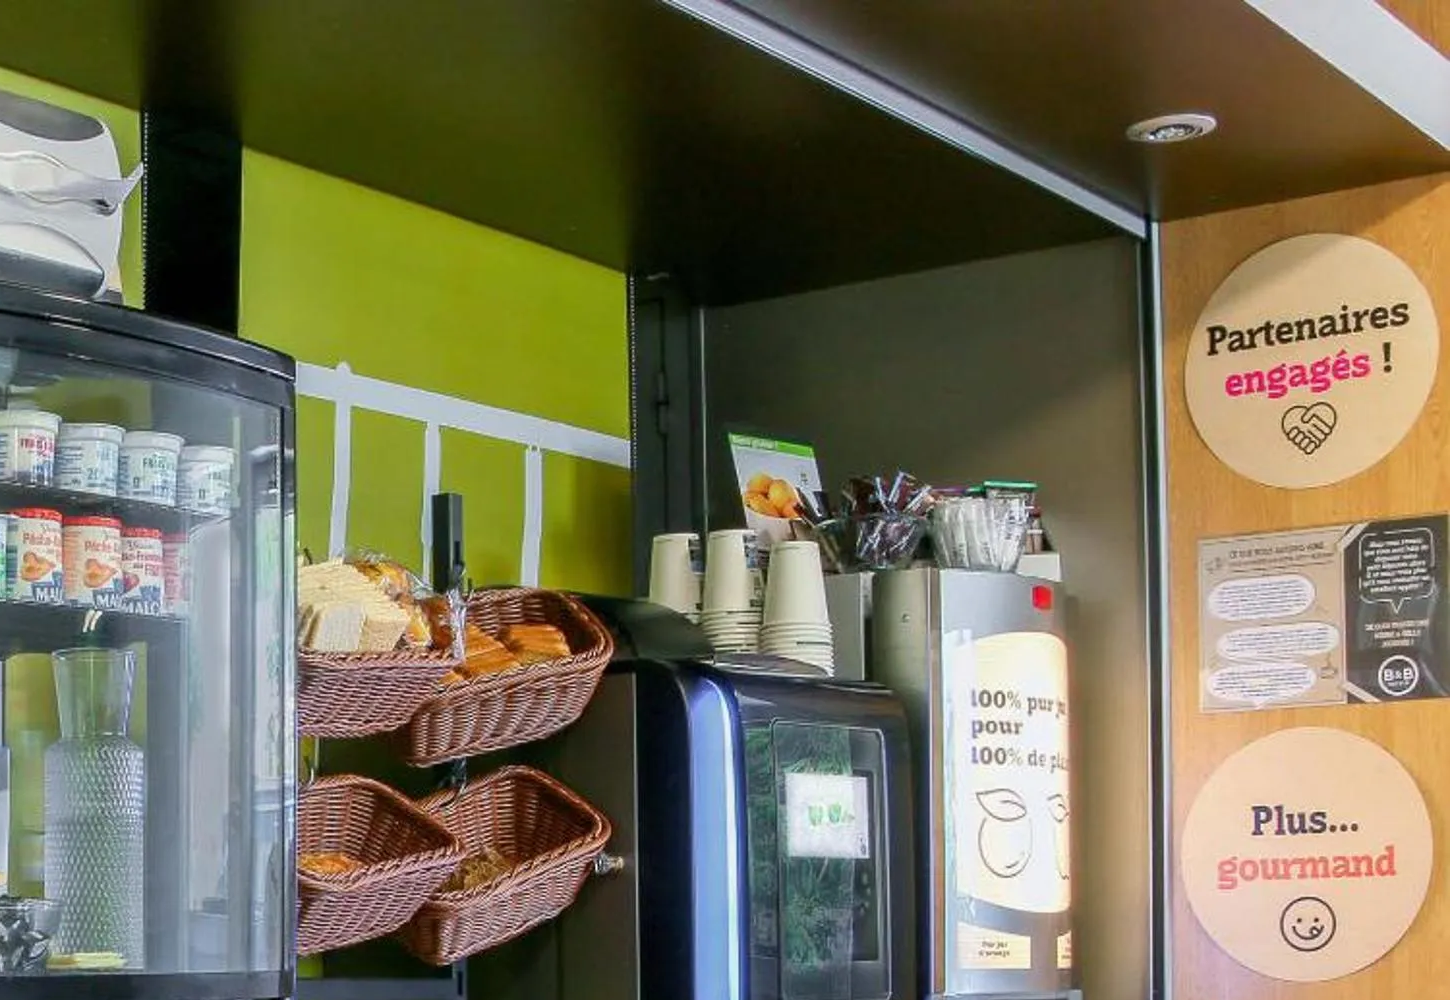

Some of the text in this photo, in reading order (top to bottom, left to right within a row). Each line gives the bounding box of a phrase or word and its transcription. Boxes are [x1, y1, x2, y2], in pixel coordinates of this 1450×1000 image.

[1206, 303, 1410, 356] Partenaires
[1225, 341, 1393, 399] engagés !
[1383, 668, 1414, 681] B&B
[970, 689, 1021, 709] 100%
[1027, 696, 1054, 717] pur
[971, 719, 1023, 738] pour
[970, 745, 1023, 766] 100%
[1027, 750, 1046, 767] de
[1251, 804, 1359, 836] Plus...
[1217, 845, 1397, 890] gourmand
